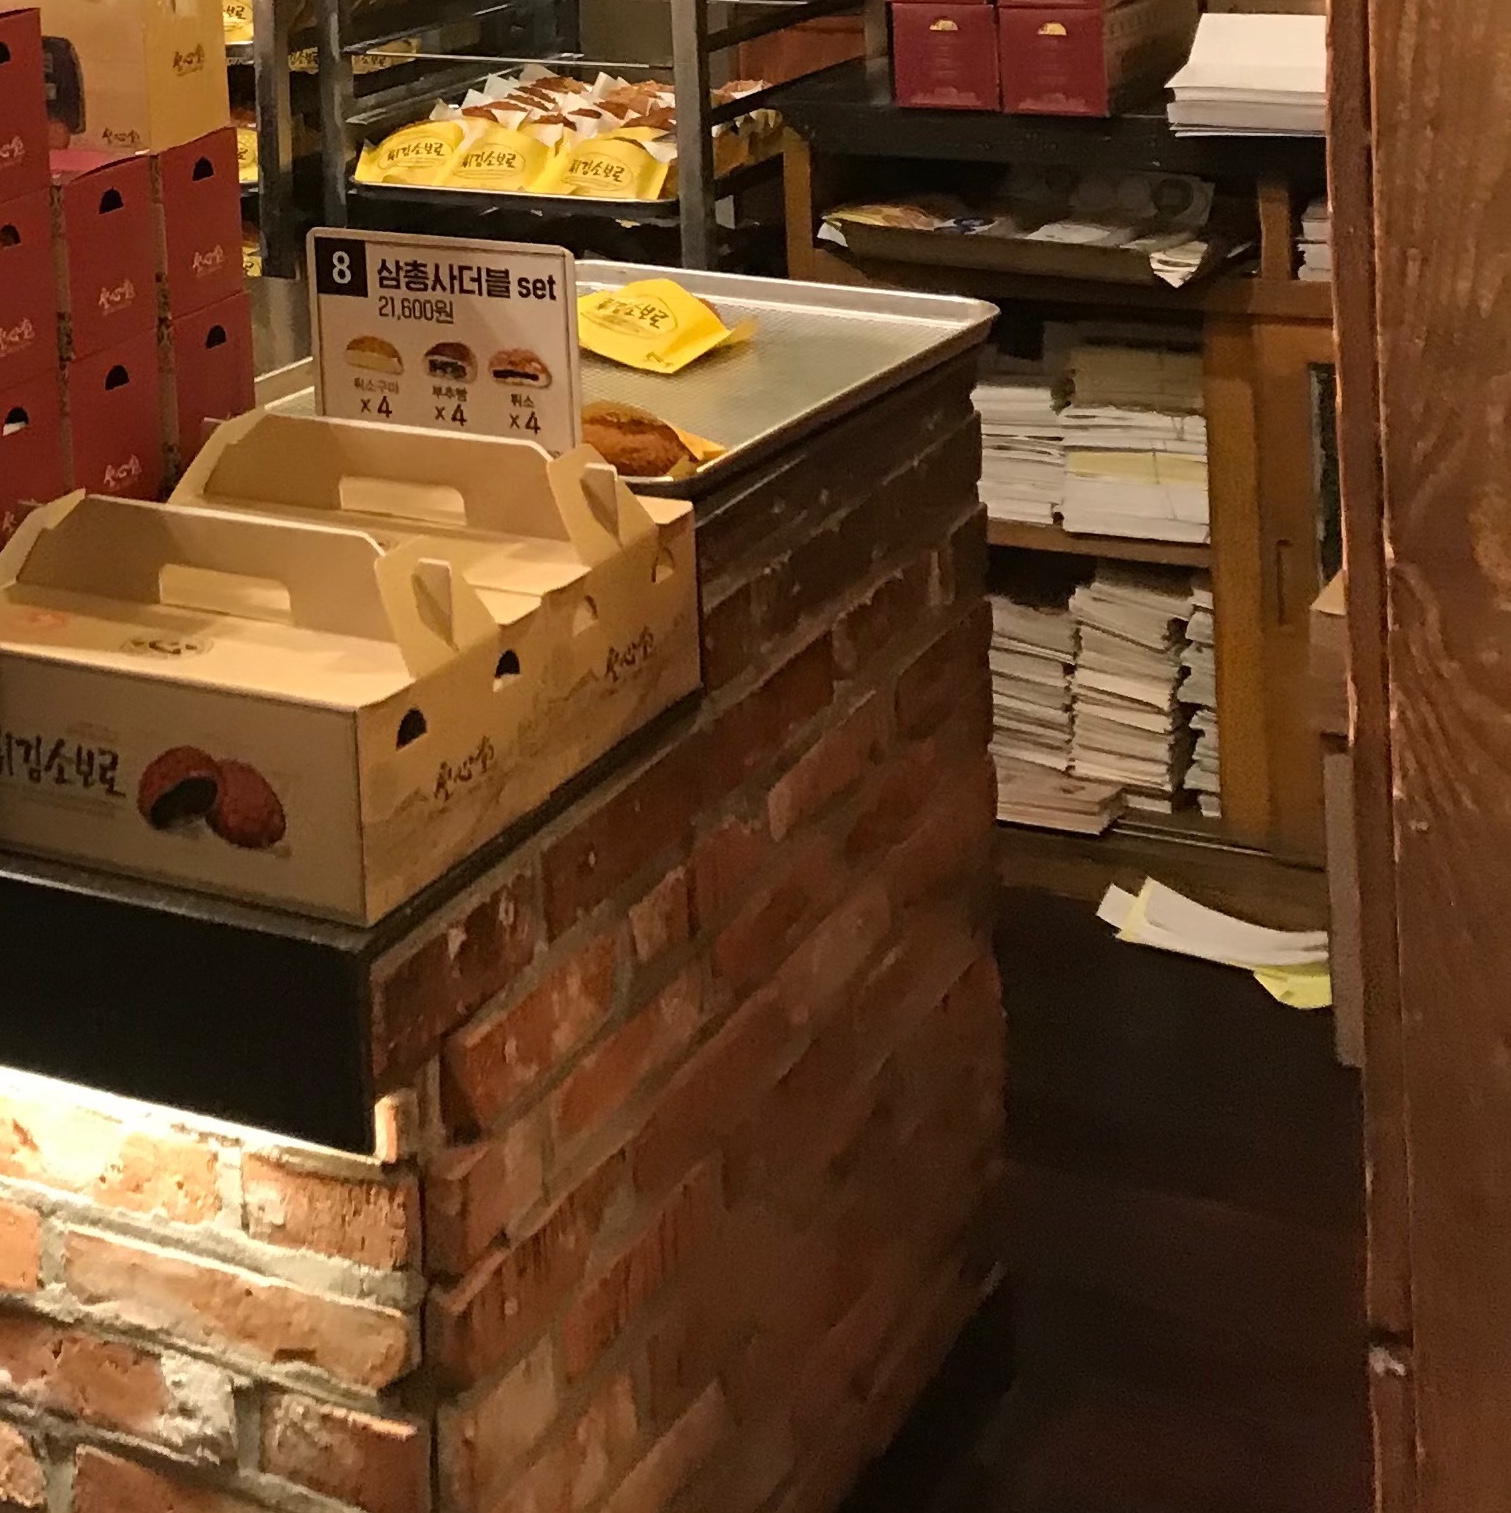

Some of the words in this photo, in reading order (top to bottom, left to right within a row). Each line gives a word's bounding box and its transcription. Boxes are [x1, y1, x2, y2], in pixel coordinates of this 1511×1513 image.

[332, 251, 352, 284] 8
[377, 258, 511, 299] 삼총사더블
[517, 274, 557, 301] set
[378, 296, 455, 325] 21,600원
